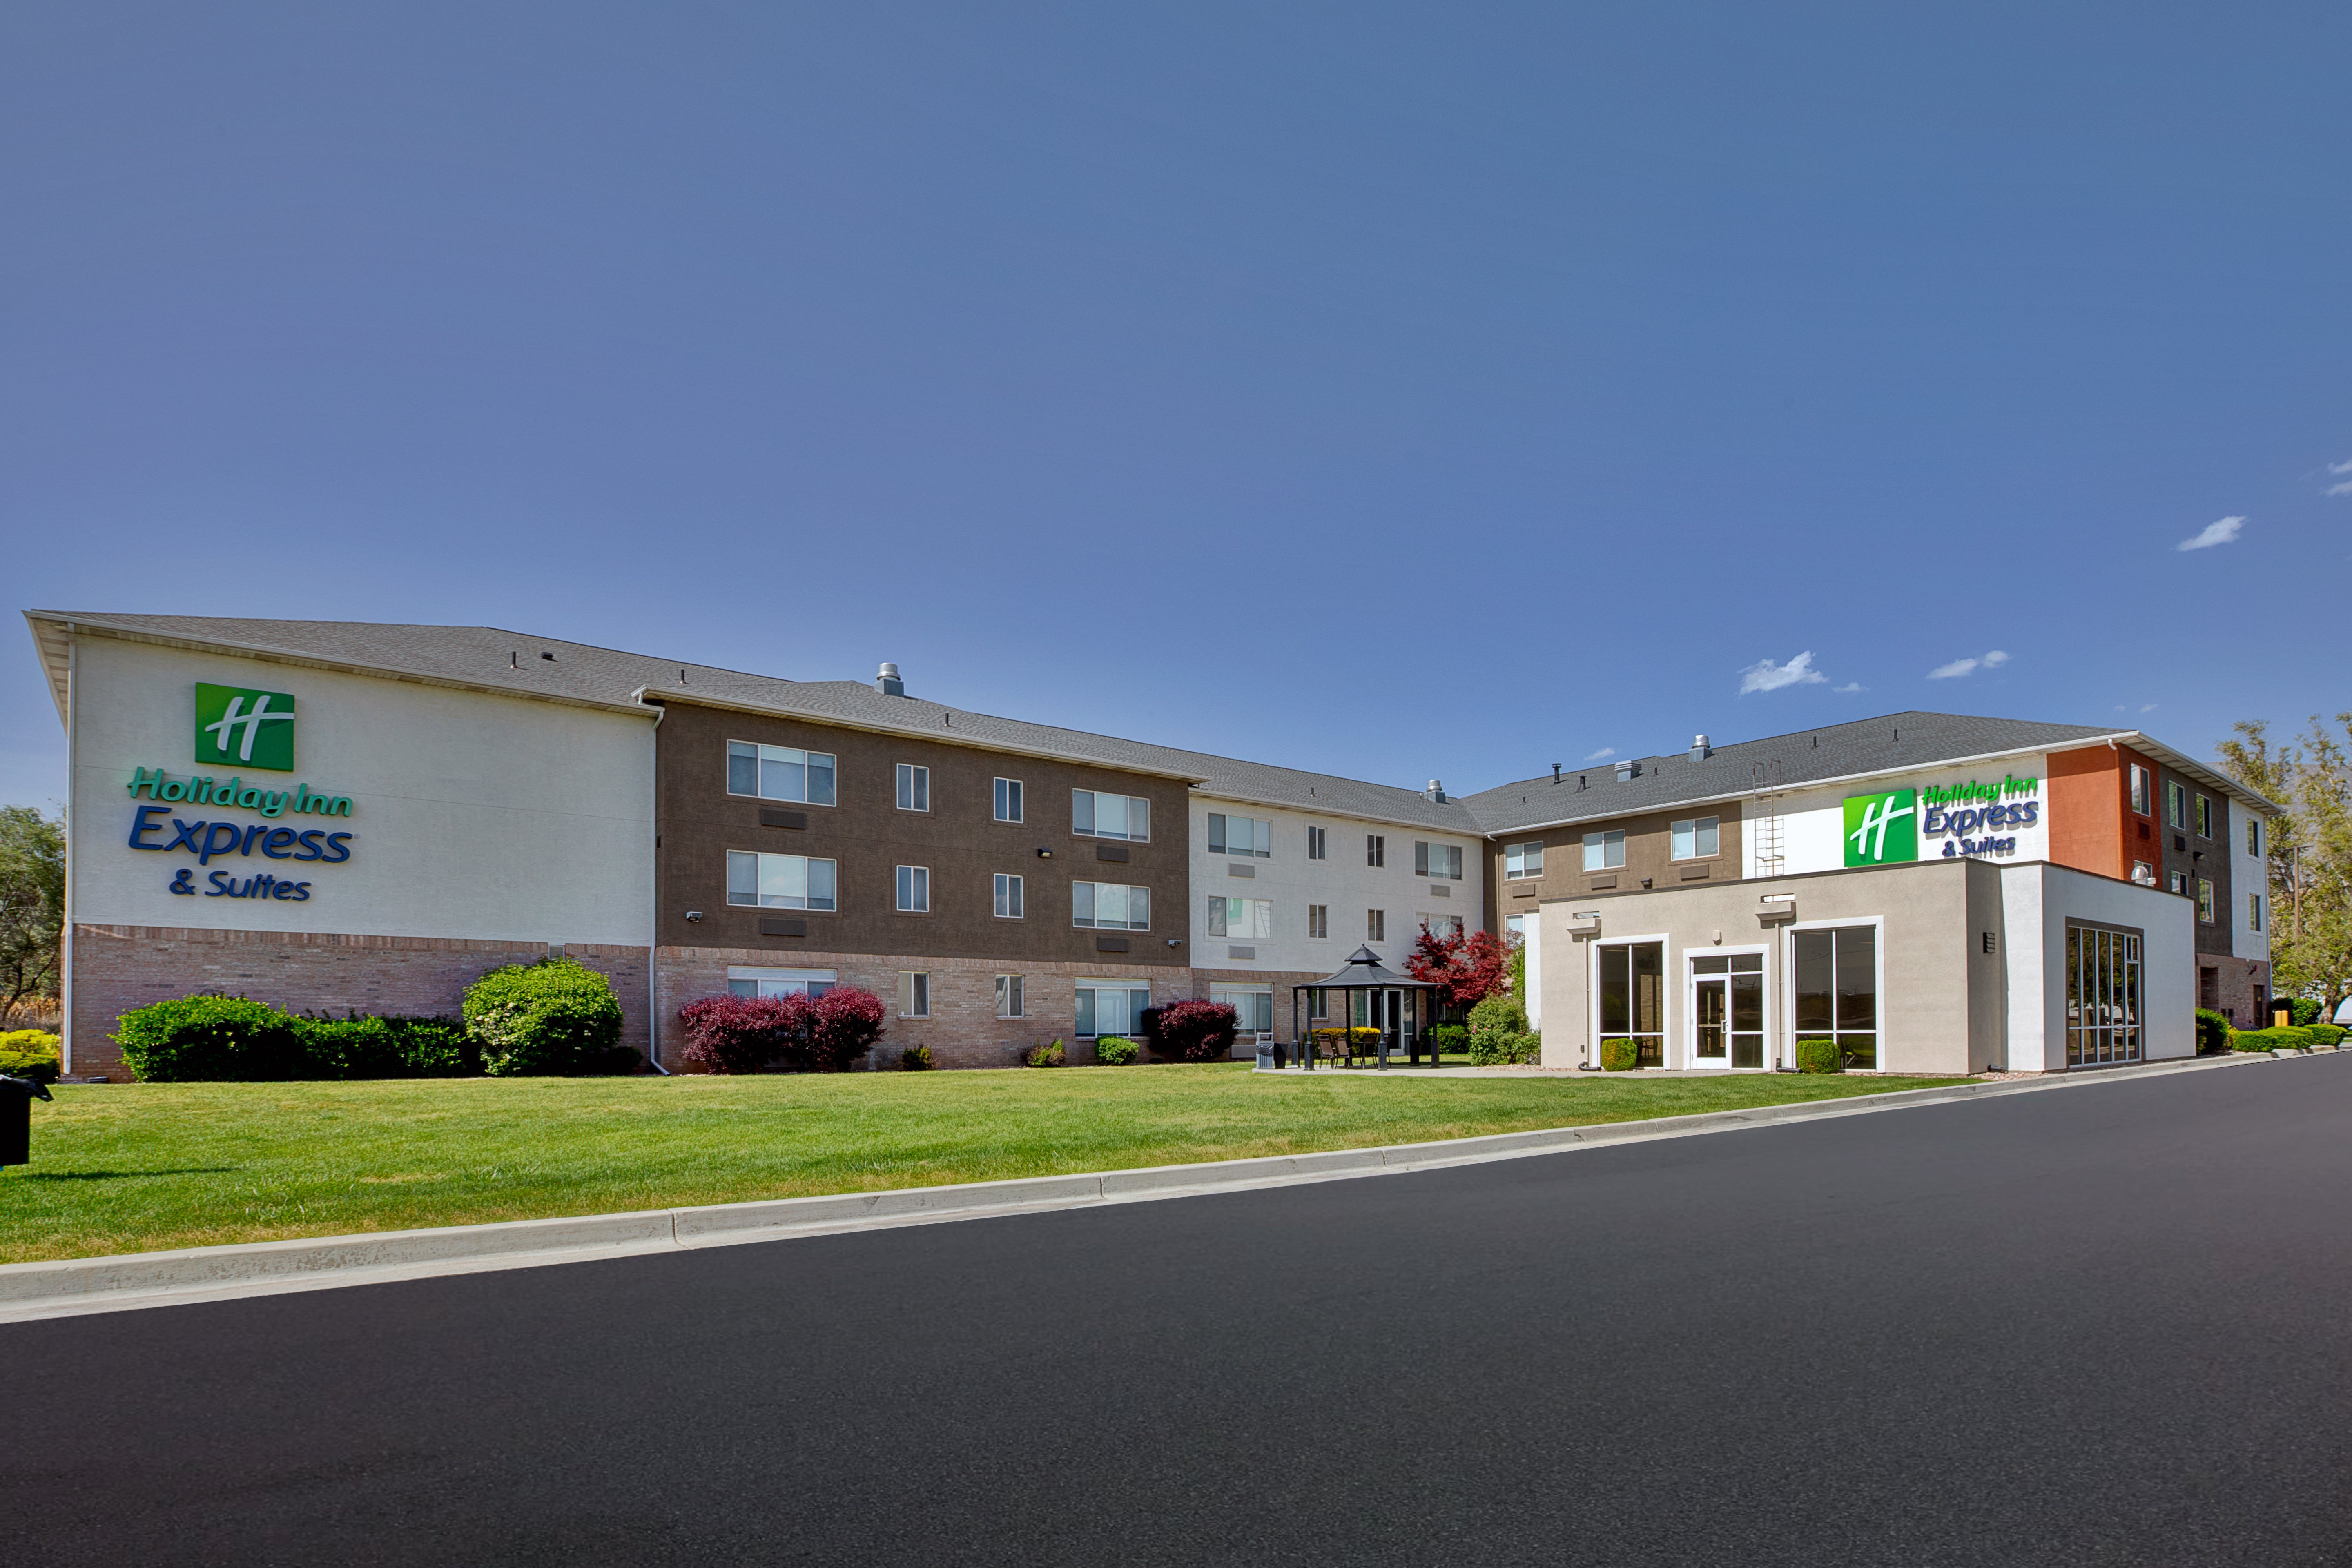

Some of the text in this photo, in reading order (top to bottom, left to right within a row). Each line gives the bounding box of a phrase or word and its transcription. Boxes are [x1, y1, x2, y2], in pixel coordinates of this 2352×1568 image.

[205, 695, 294, 760] H
[127, 766, 353, 817] Holiday Inn
[1922, 775, 2037, 805] Holiday Inn
[128, 805, 352, 866] Express
[1850, 796, 1913, 860] H
[1923, 801, 2039, 837] Express
[1942, 836, 2015, 857] & Suites
[169, 869, 312, 901] & Suites
